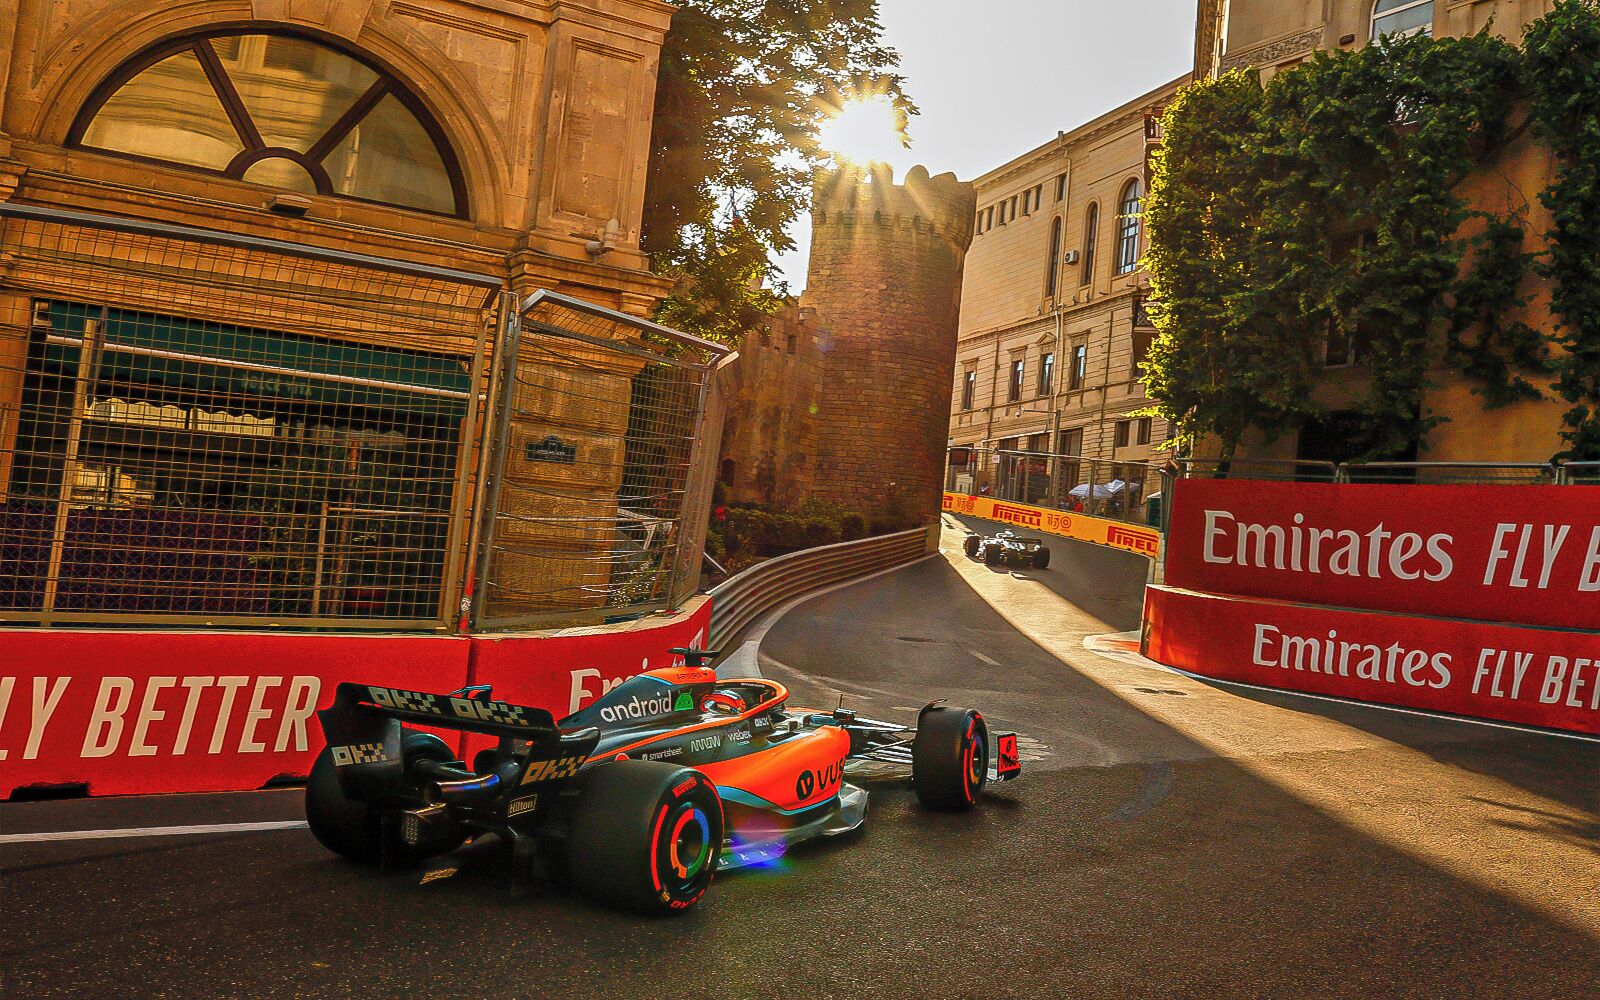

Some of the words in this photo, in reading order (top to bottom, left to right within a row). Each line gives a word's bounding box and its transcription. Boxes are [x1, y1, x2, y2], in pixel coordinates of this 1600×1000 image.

[992, 503, 1042, 526] PIRELLI
[1047, 513, 1072, 530] 150
[1203, 509, 1454, 582] Emirates
[1483, 523, 1571, 589] FLY
[1252, 623, 1453, 689] Emirates
[1471, 647, 1534, 699] FLY
[80, 675, 321, 758] BETTER
[368, 686, 441, 714] OKX
[449, 697, 529, 726] OKX
[600, 690, 672, 722] android
[331, 742, 388, 767] OKX
[520, 755, 586, 786] OKX
[510, 800, 533, 814] Hilton
